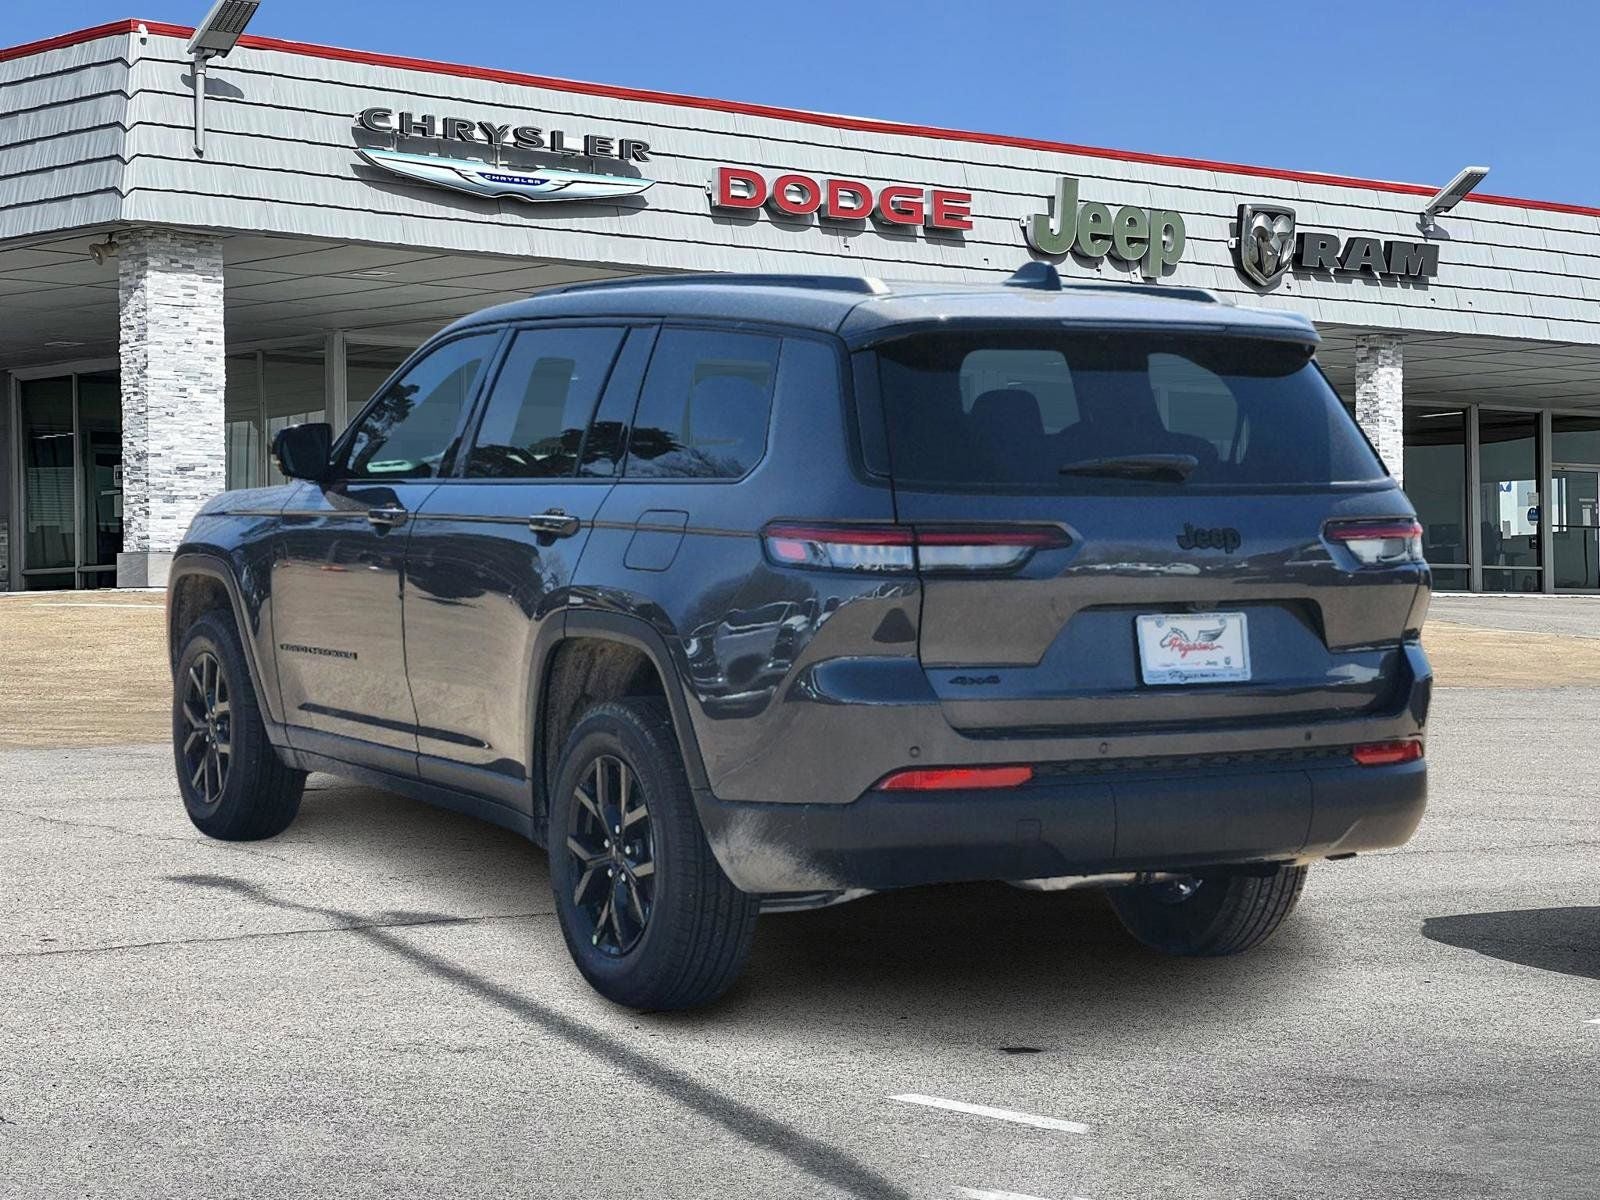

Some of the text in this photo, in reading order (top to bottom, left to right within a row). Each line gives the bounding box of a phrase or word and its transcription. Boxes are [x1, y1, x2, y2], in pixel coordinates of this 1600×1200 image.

[358, 107, 651, 162] CHRYSLER
[484, 174, 541, 185] CHRYSLER
[712, 167, 973, 230] DODGE
[1024, 177, 1186, 278] Jeep
[1296, 232, 1440, 278] RAM
[1176, 521, 1241, 554] Jeep
